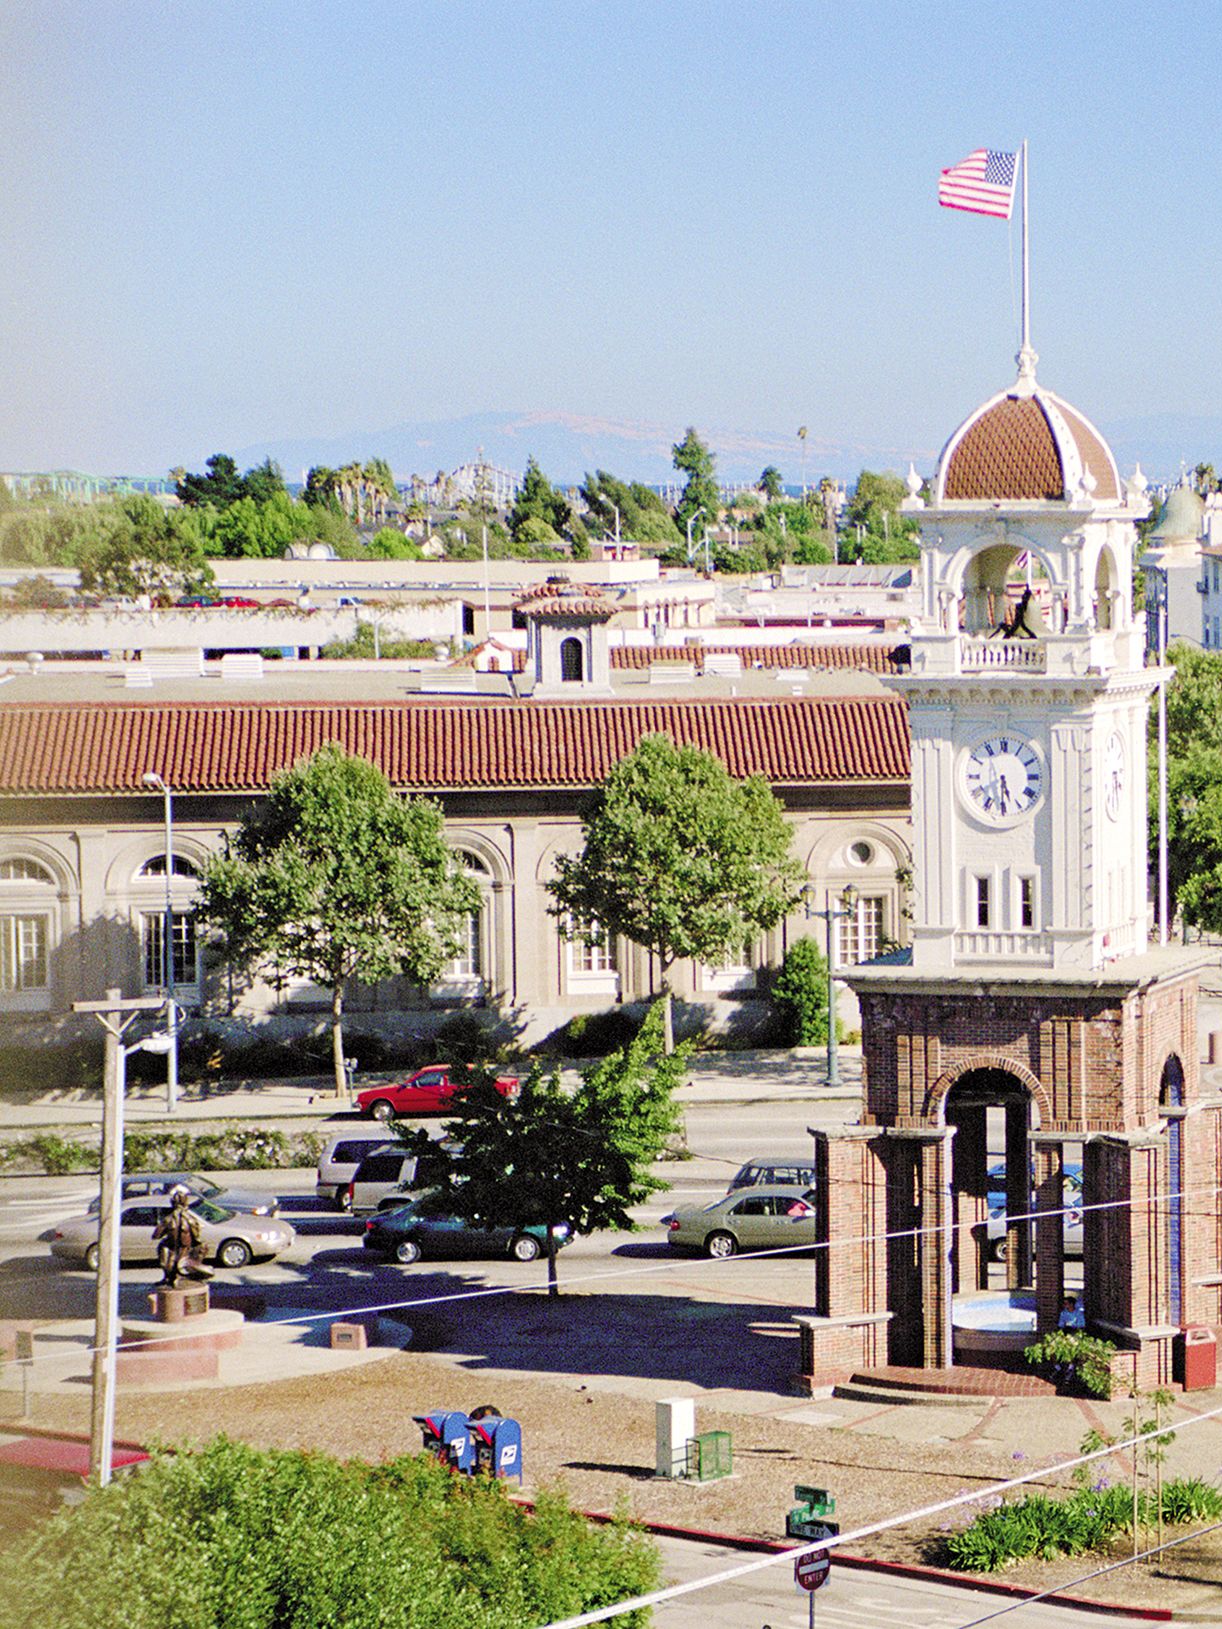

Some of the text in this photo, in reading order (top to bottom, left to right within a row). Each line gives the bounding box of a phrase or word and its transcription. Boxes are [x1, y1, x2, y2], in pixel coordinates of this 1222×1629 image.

[803, 1549, 825, 1563] DO NOT
[804, 1570, 824, 1585] ENTER
